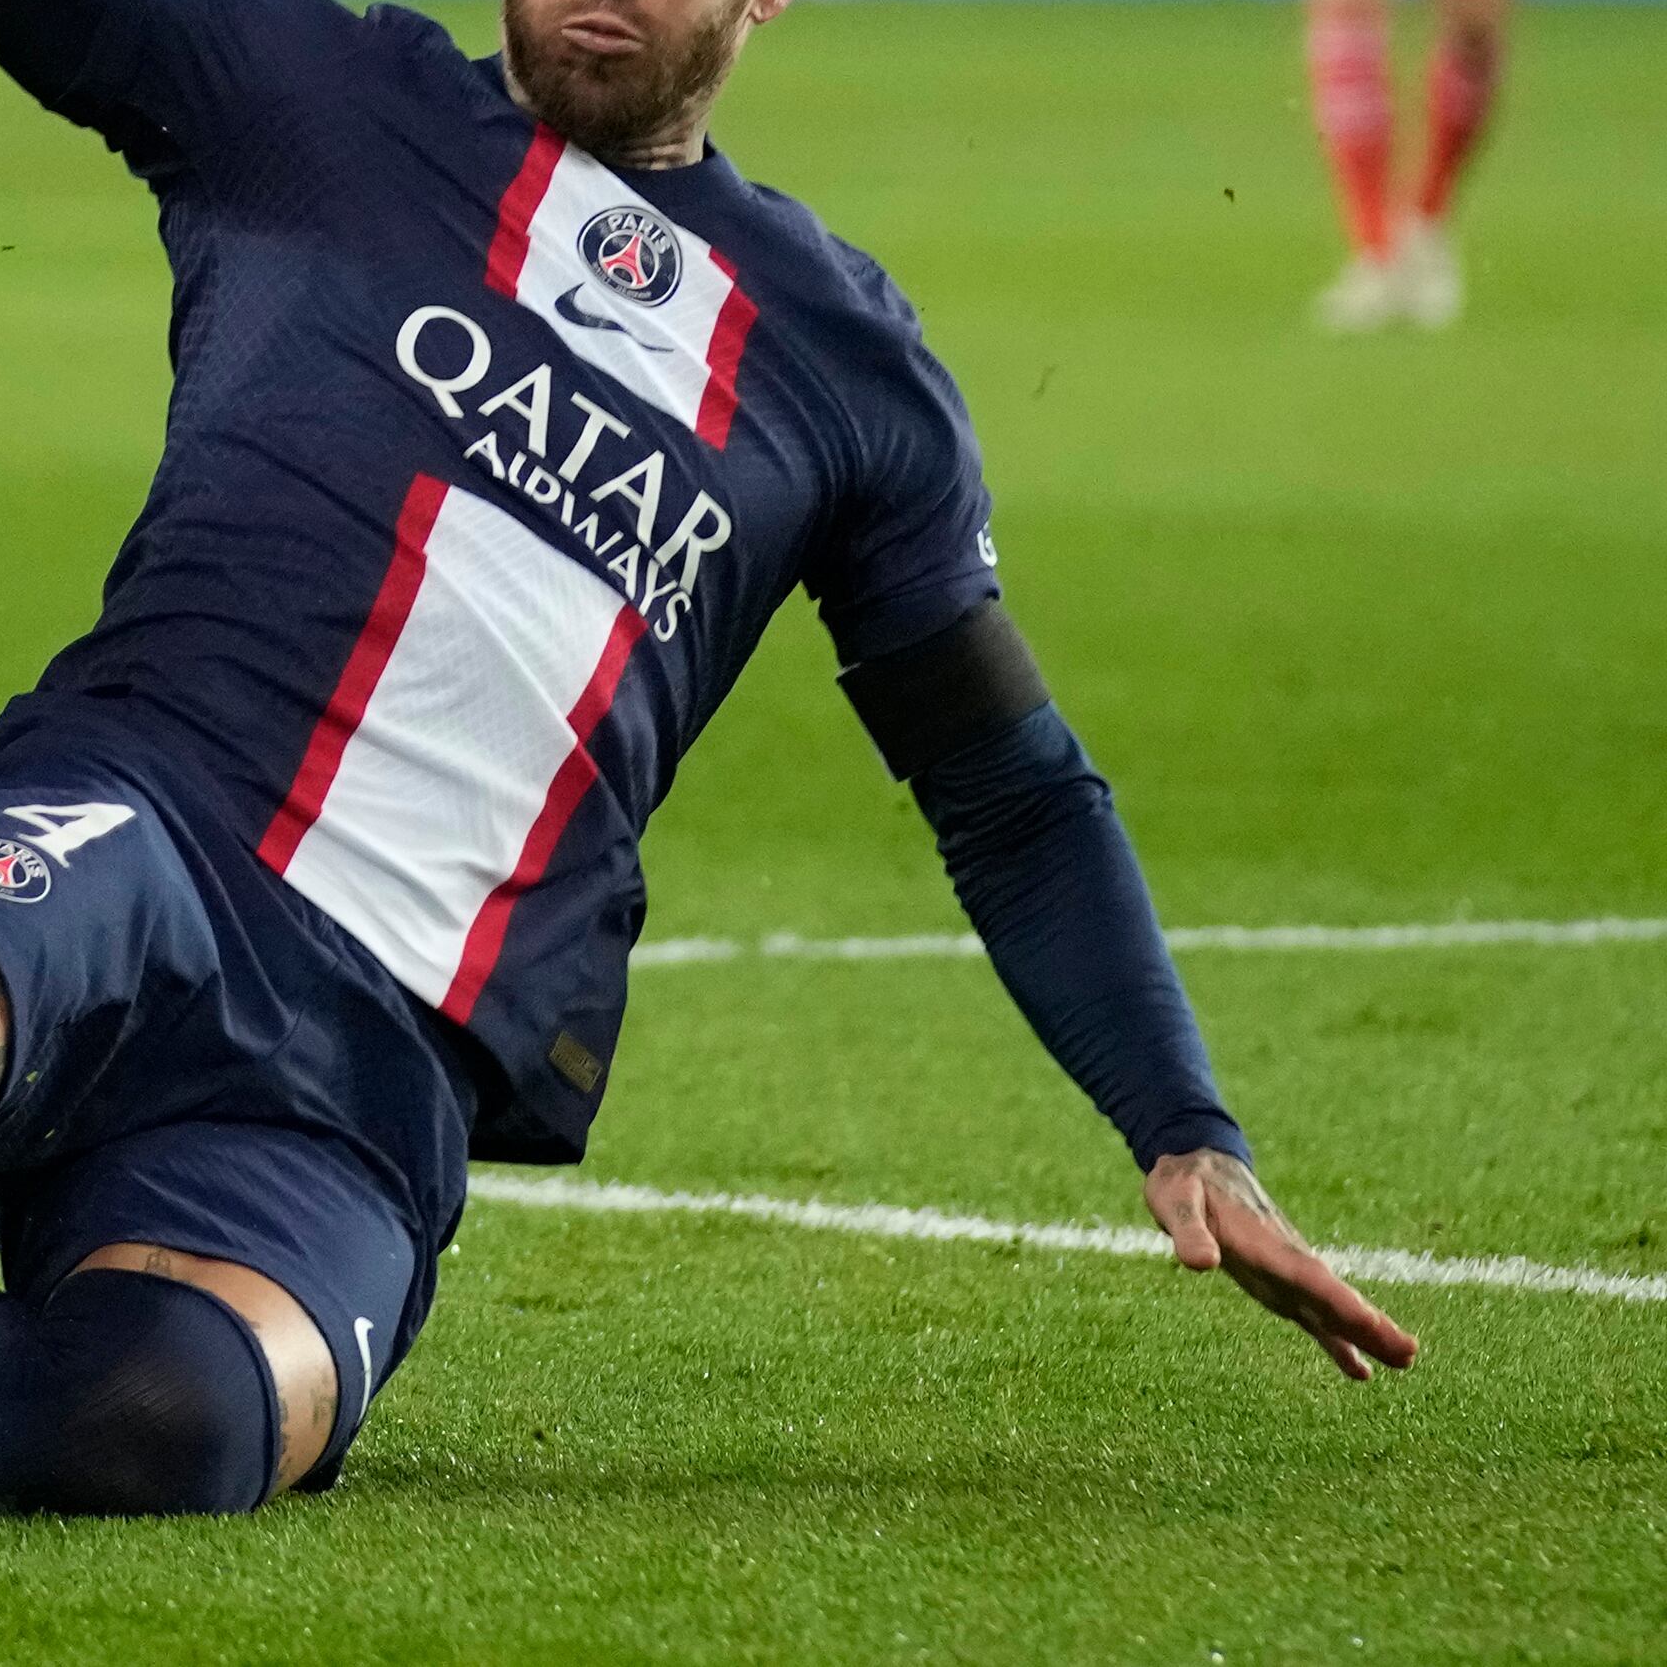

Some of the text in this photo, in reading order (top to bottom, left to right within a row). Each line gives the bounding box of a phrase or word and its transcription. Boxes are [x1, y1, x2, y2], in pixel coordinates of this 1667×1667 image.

[606, 212, 672, 255] PARIS
[395, 304, 732, 597] QATAR
[3, 802, 137, 869] 4
